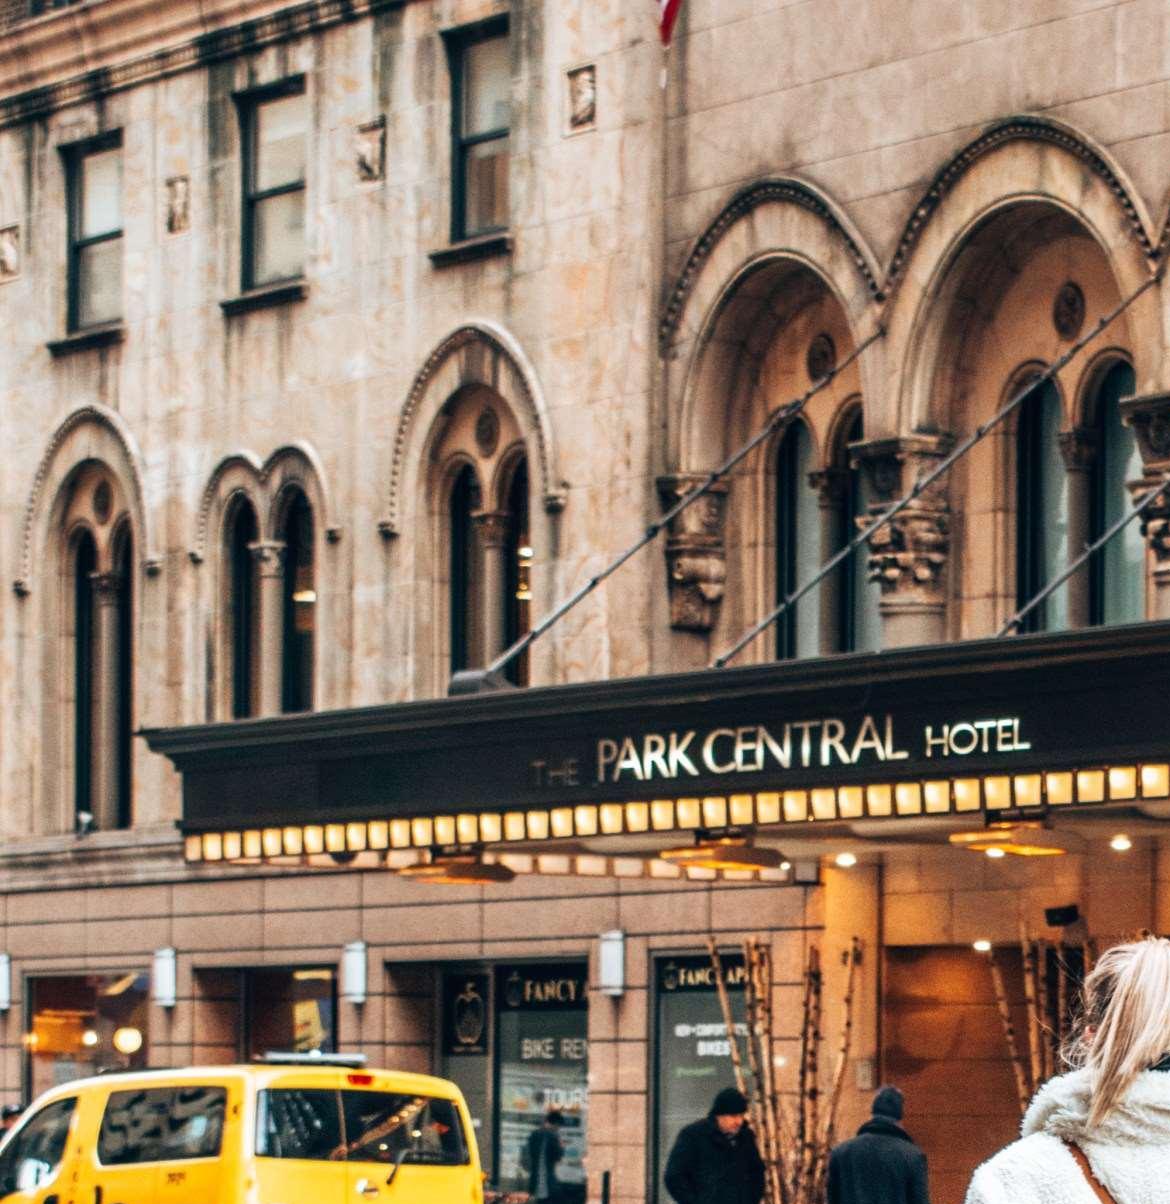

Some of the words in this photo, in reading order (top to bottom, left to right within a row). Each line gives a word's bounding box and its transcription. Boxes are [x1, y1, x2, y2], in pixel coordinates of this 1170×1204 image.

[530, 761, 579, 786] THE
[596, 731, 699, 783] PARK
[703, 715, 909, 775] CENTRAL
[924, 718, 1031, 758] HOTEL
[523, 979, 577, 1001] FANCY
[522, 1037, 555, 1060] BIKE
